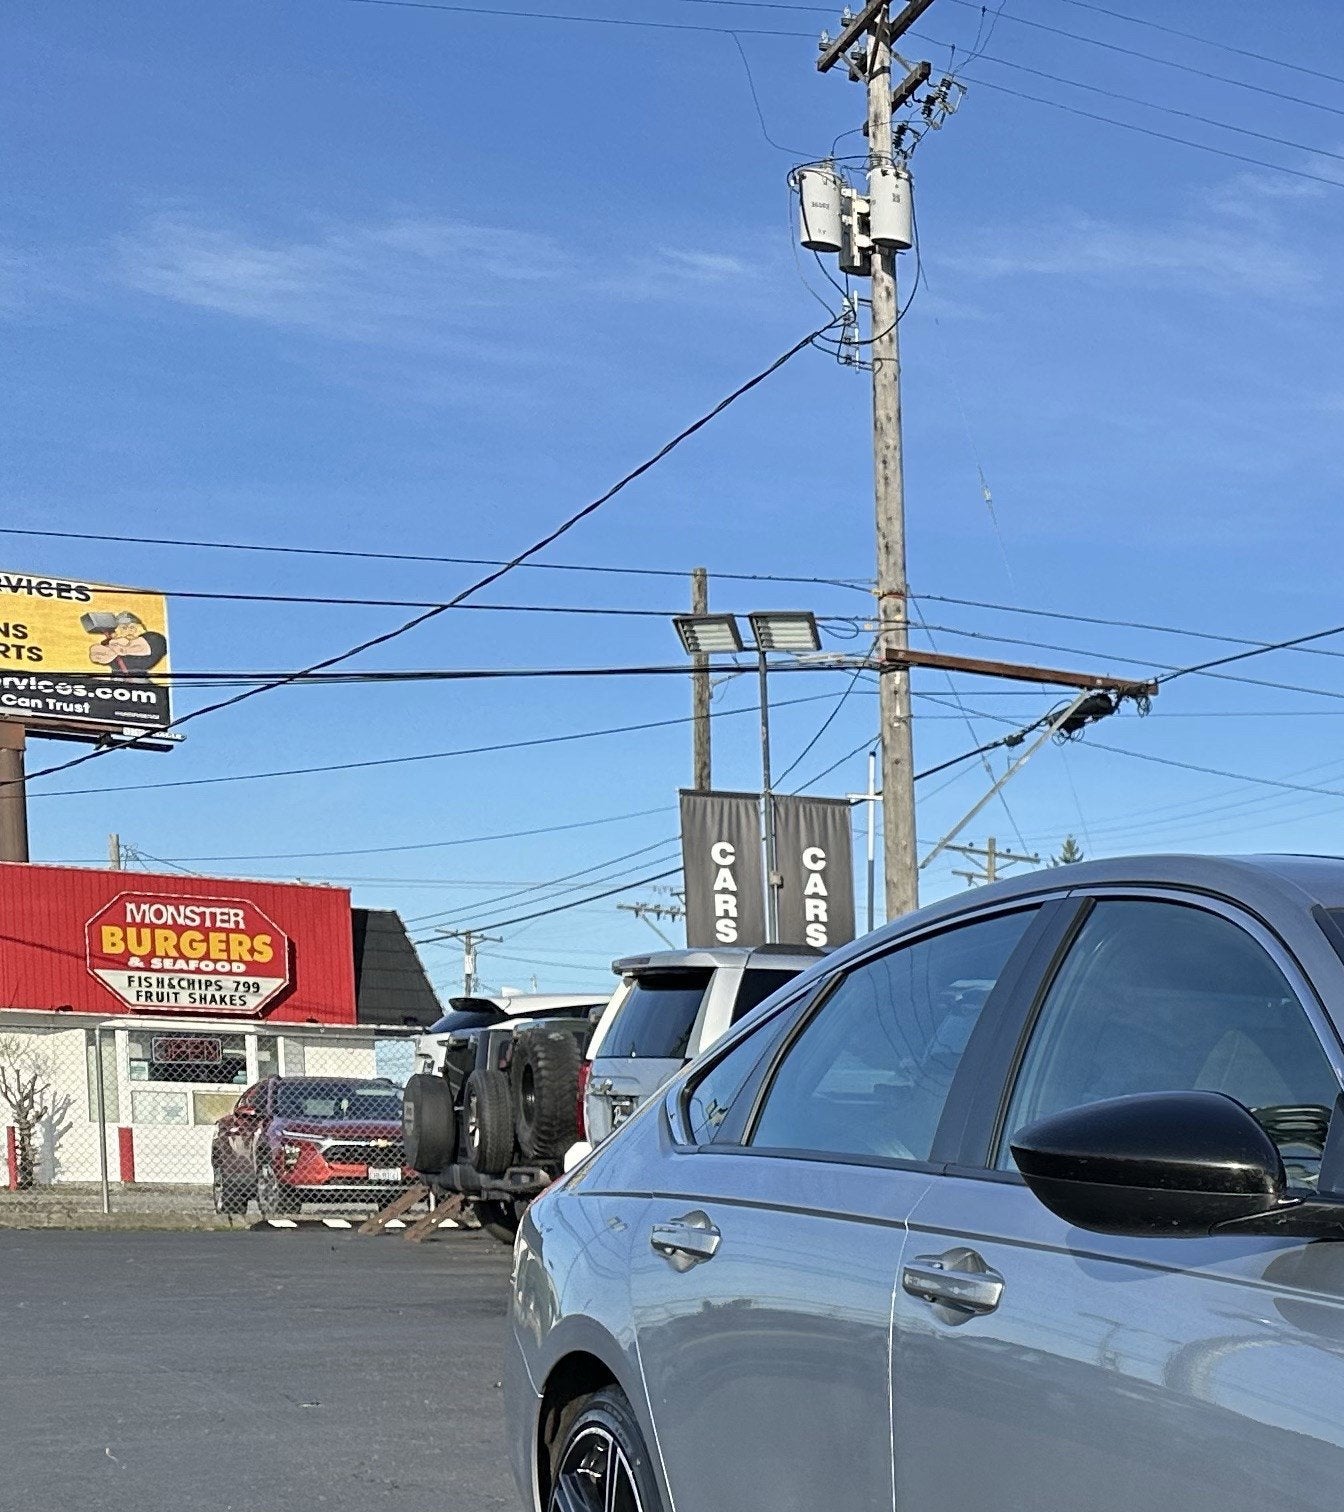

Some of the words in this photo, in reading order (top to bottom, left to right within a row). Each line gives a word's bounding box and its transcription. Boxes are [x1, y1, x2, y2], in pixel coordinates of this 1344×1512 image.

[0, 575, 91, 602] VICES
[1, 692, 43, 708] Can
[46, 698, 91, 714] Trust
[711, 841, 738, 943] CARS
[802, 847, 828, 947] CARS
[125, 902, 246, 930] MONSTER
[101, 925, 274, 964] BURGERS
[127, 956, 145, 969] &
[151, 957, 247, 974] SEAFOOD
[127, 975, 223, 992] FISH&CHIPS
[232, 980, 260, 994] 799
[136, 990, 180, 1004] FRUIT
[188, 992, 248, 1007] SHAKES
